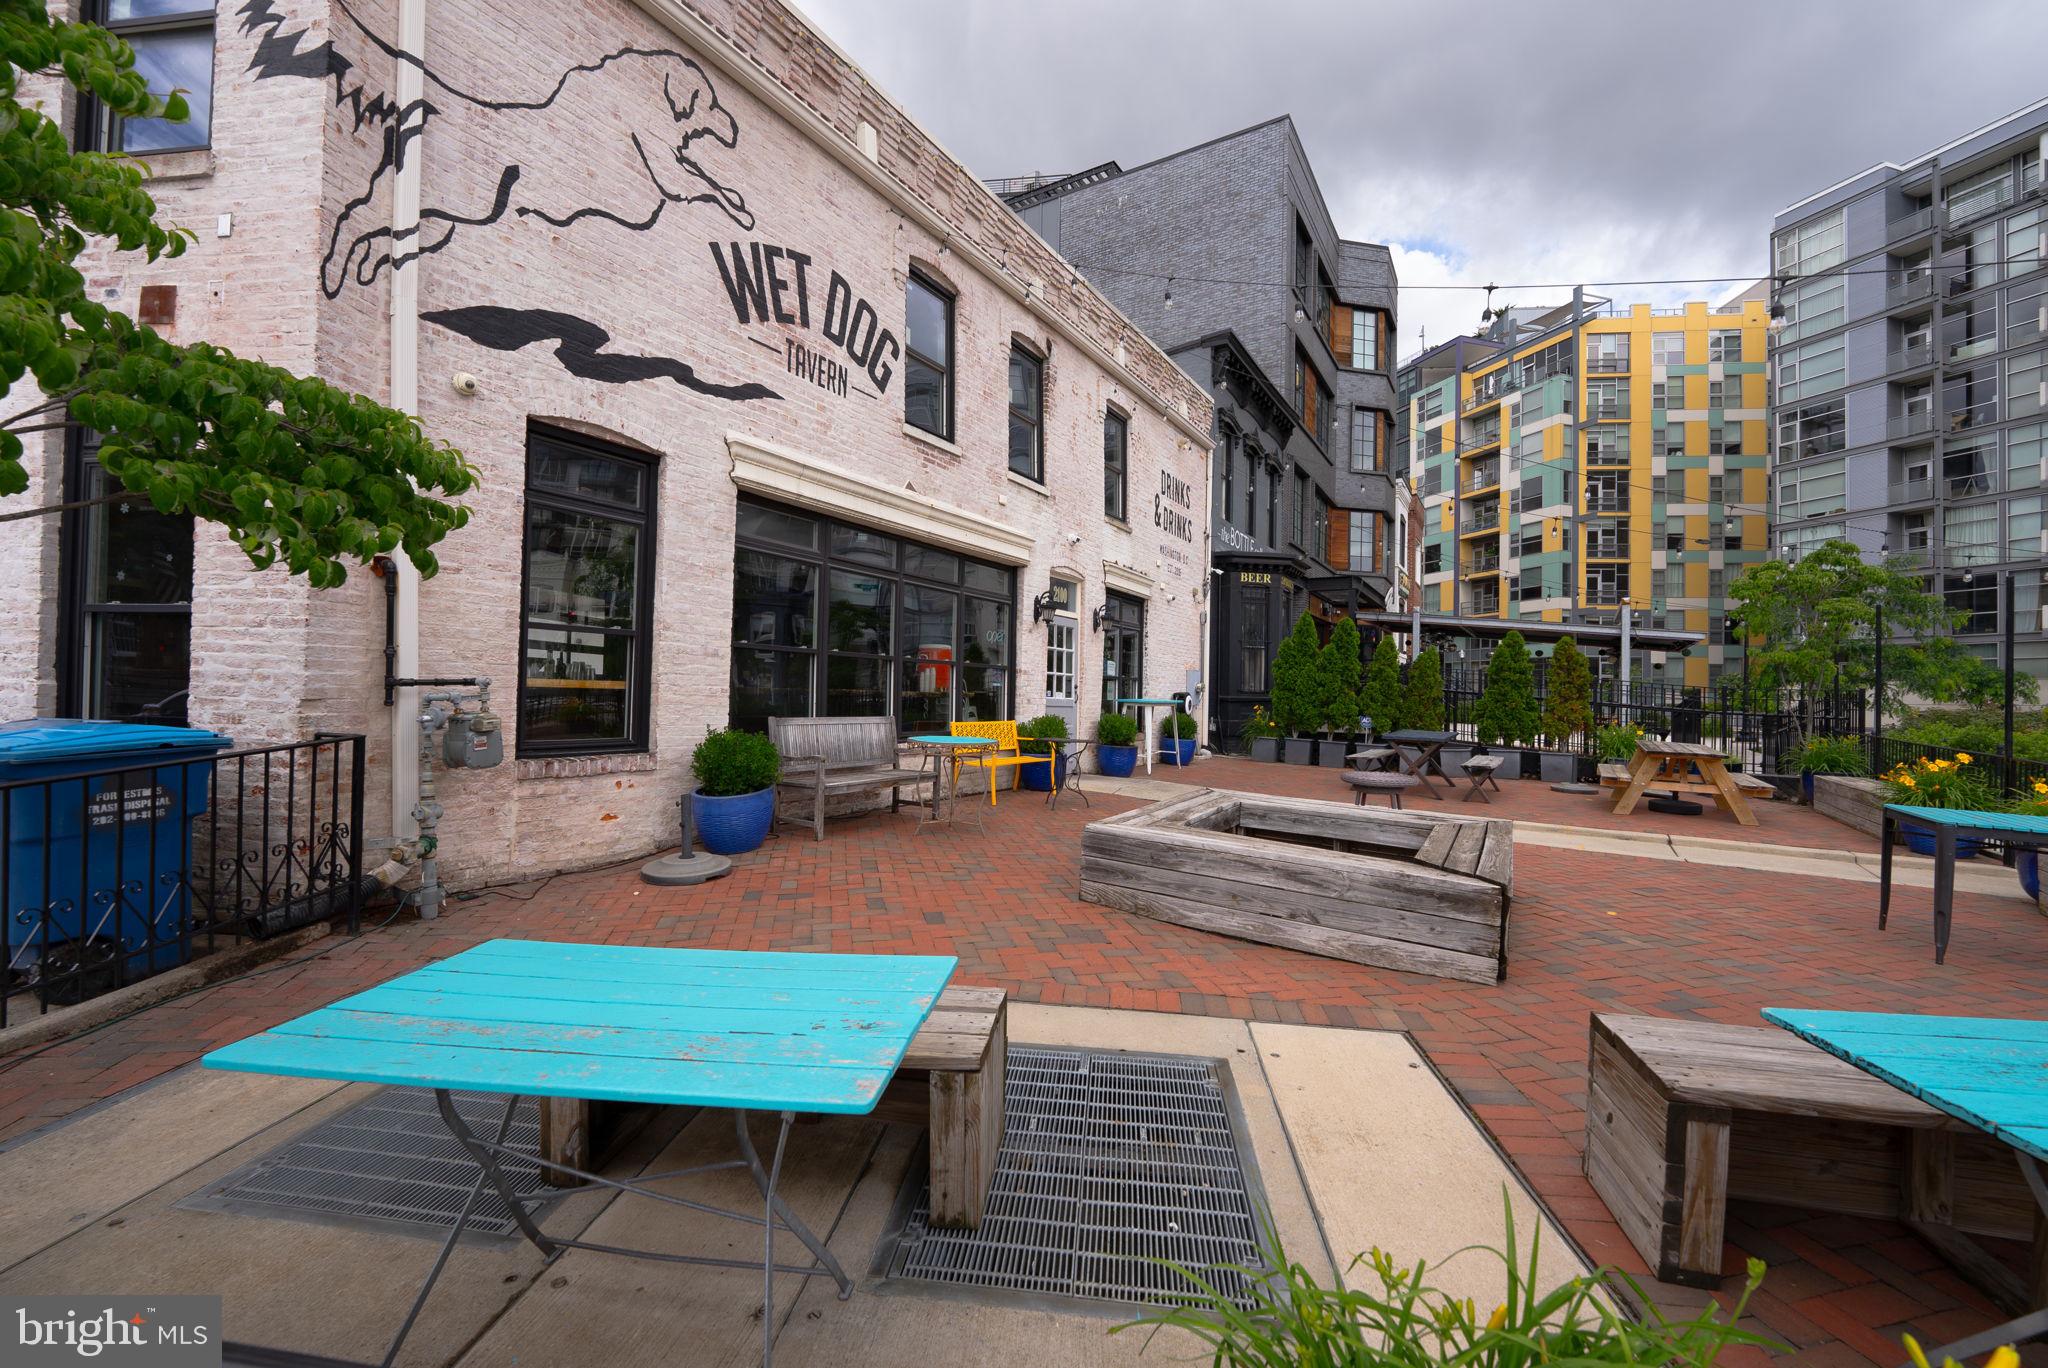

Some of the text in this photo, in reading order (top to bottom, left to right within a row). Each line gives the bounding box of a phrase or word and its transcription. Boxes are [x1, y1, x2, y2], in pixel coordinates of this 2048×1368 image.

[708, 241, 901, 395] WET DOG
[785, 337, 849, 399] TAVERN
[1161, 469, 1191, 510] DRINKS
[1154, 493, 1192, 544] & DRINKS
[1219, 526, 1230, 544] the
[1053, 585, 1068, 604] 2100
[1240, 572, 1272, 584] BEER
